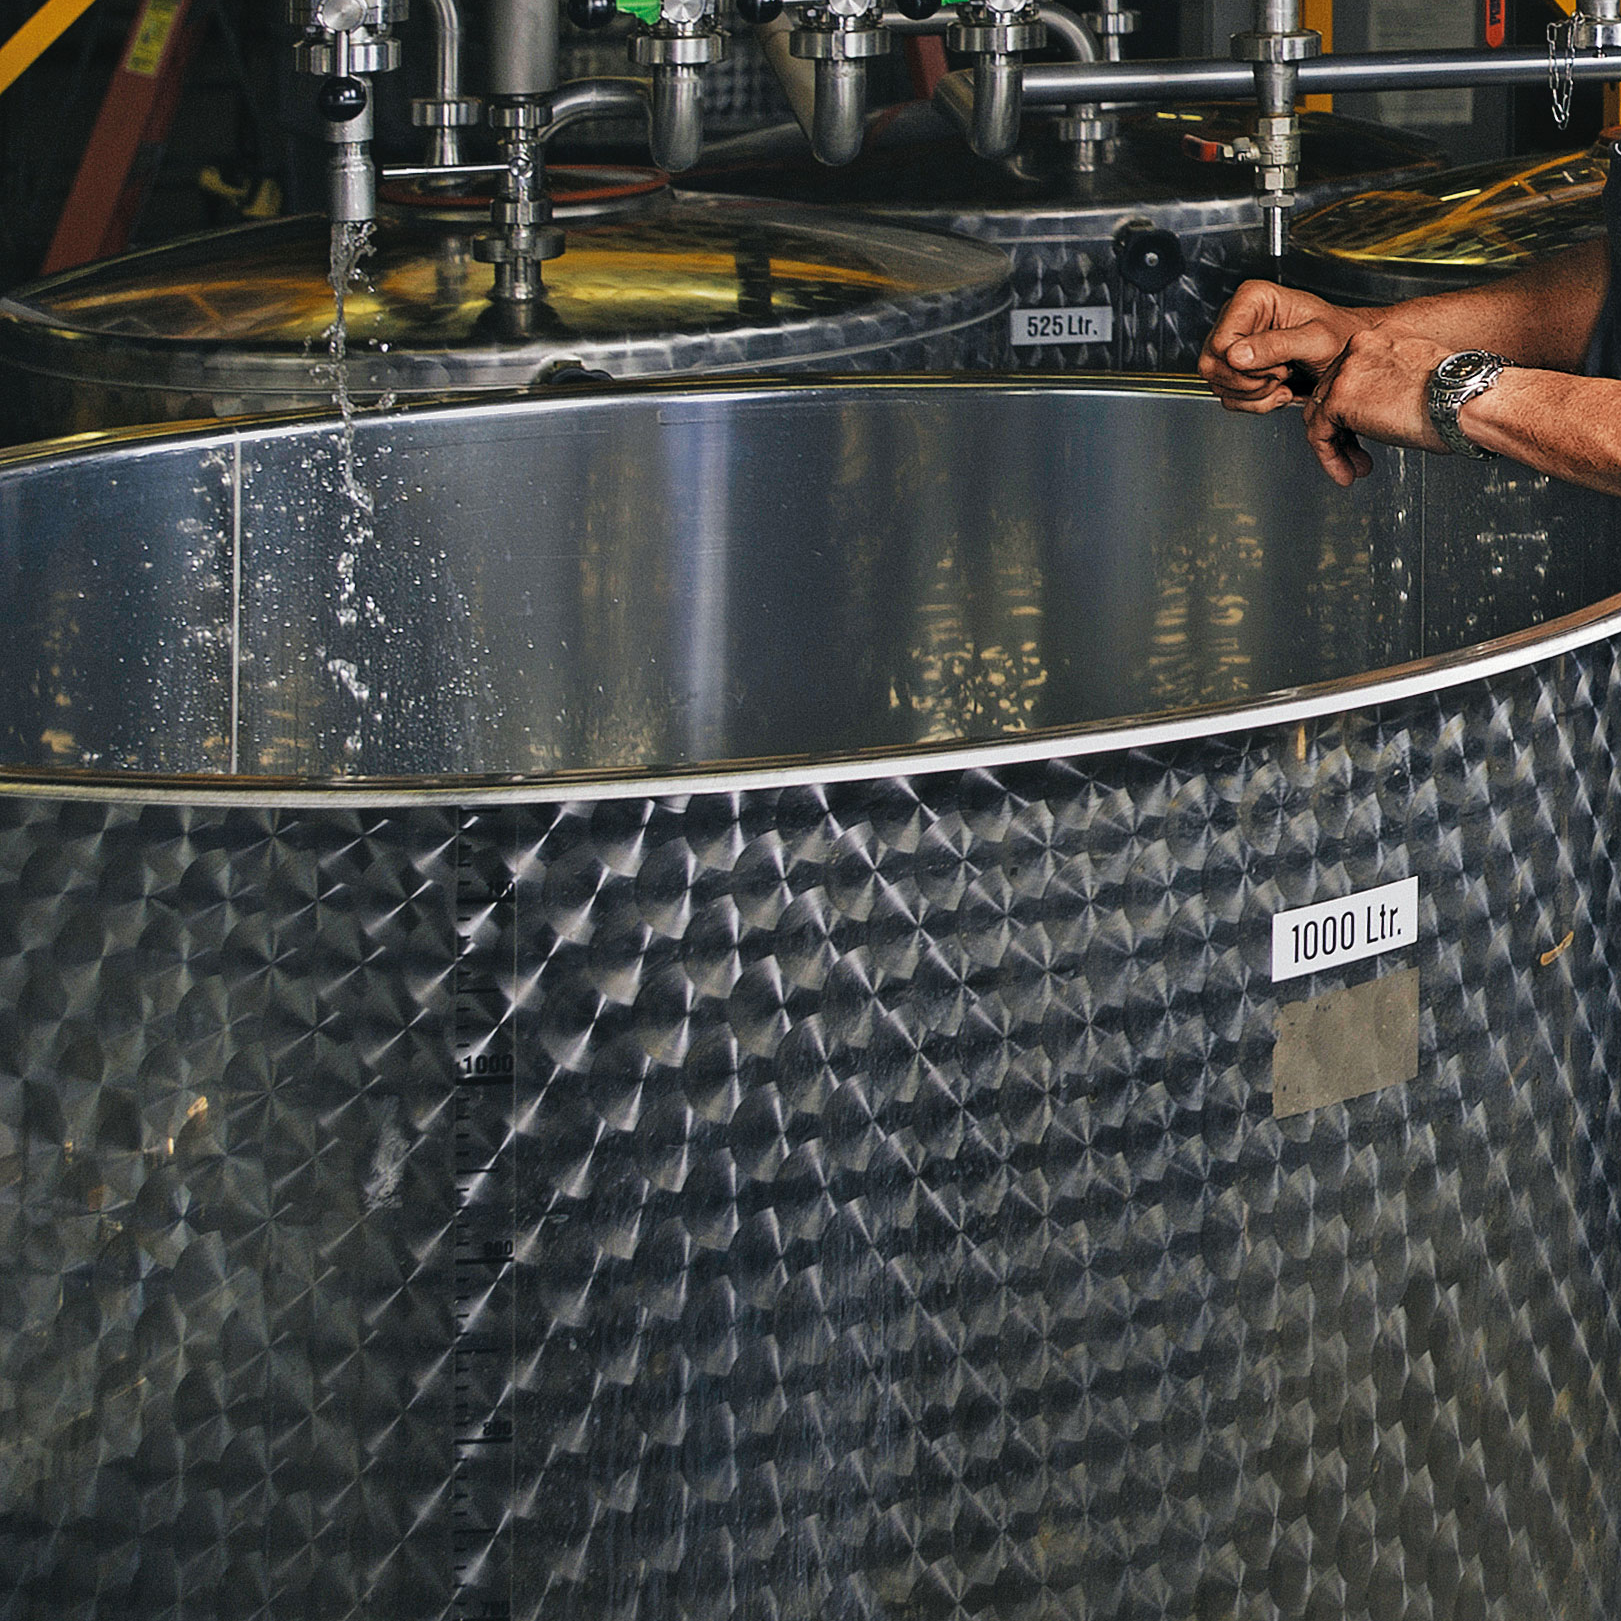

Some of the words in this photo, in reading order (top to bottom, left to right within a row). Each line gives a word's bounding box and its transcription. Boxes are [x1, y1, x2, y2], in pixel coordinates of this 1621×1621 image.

[1027, 315, 1064, 337] 525
[1068, 315, 1098, 336] Ltr.
[1291, 911, 1355, 964] 1000
[1366, 904, 1402, 945] Ltr.
